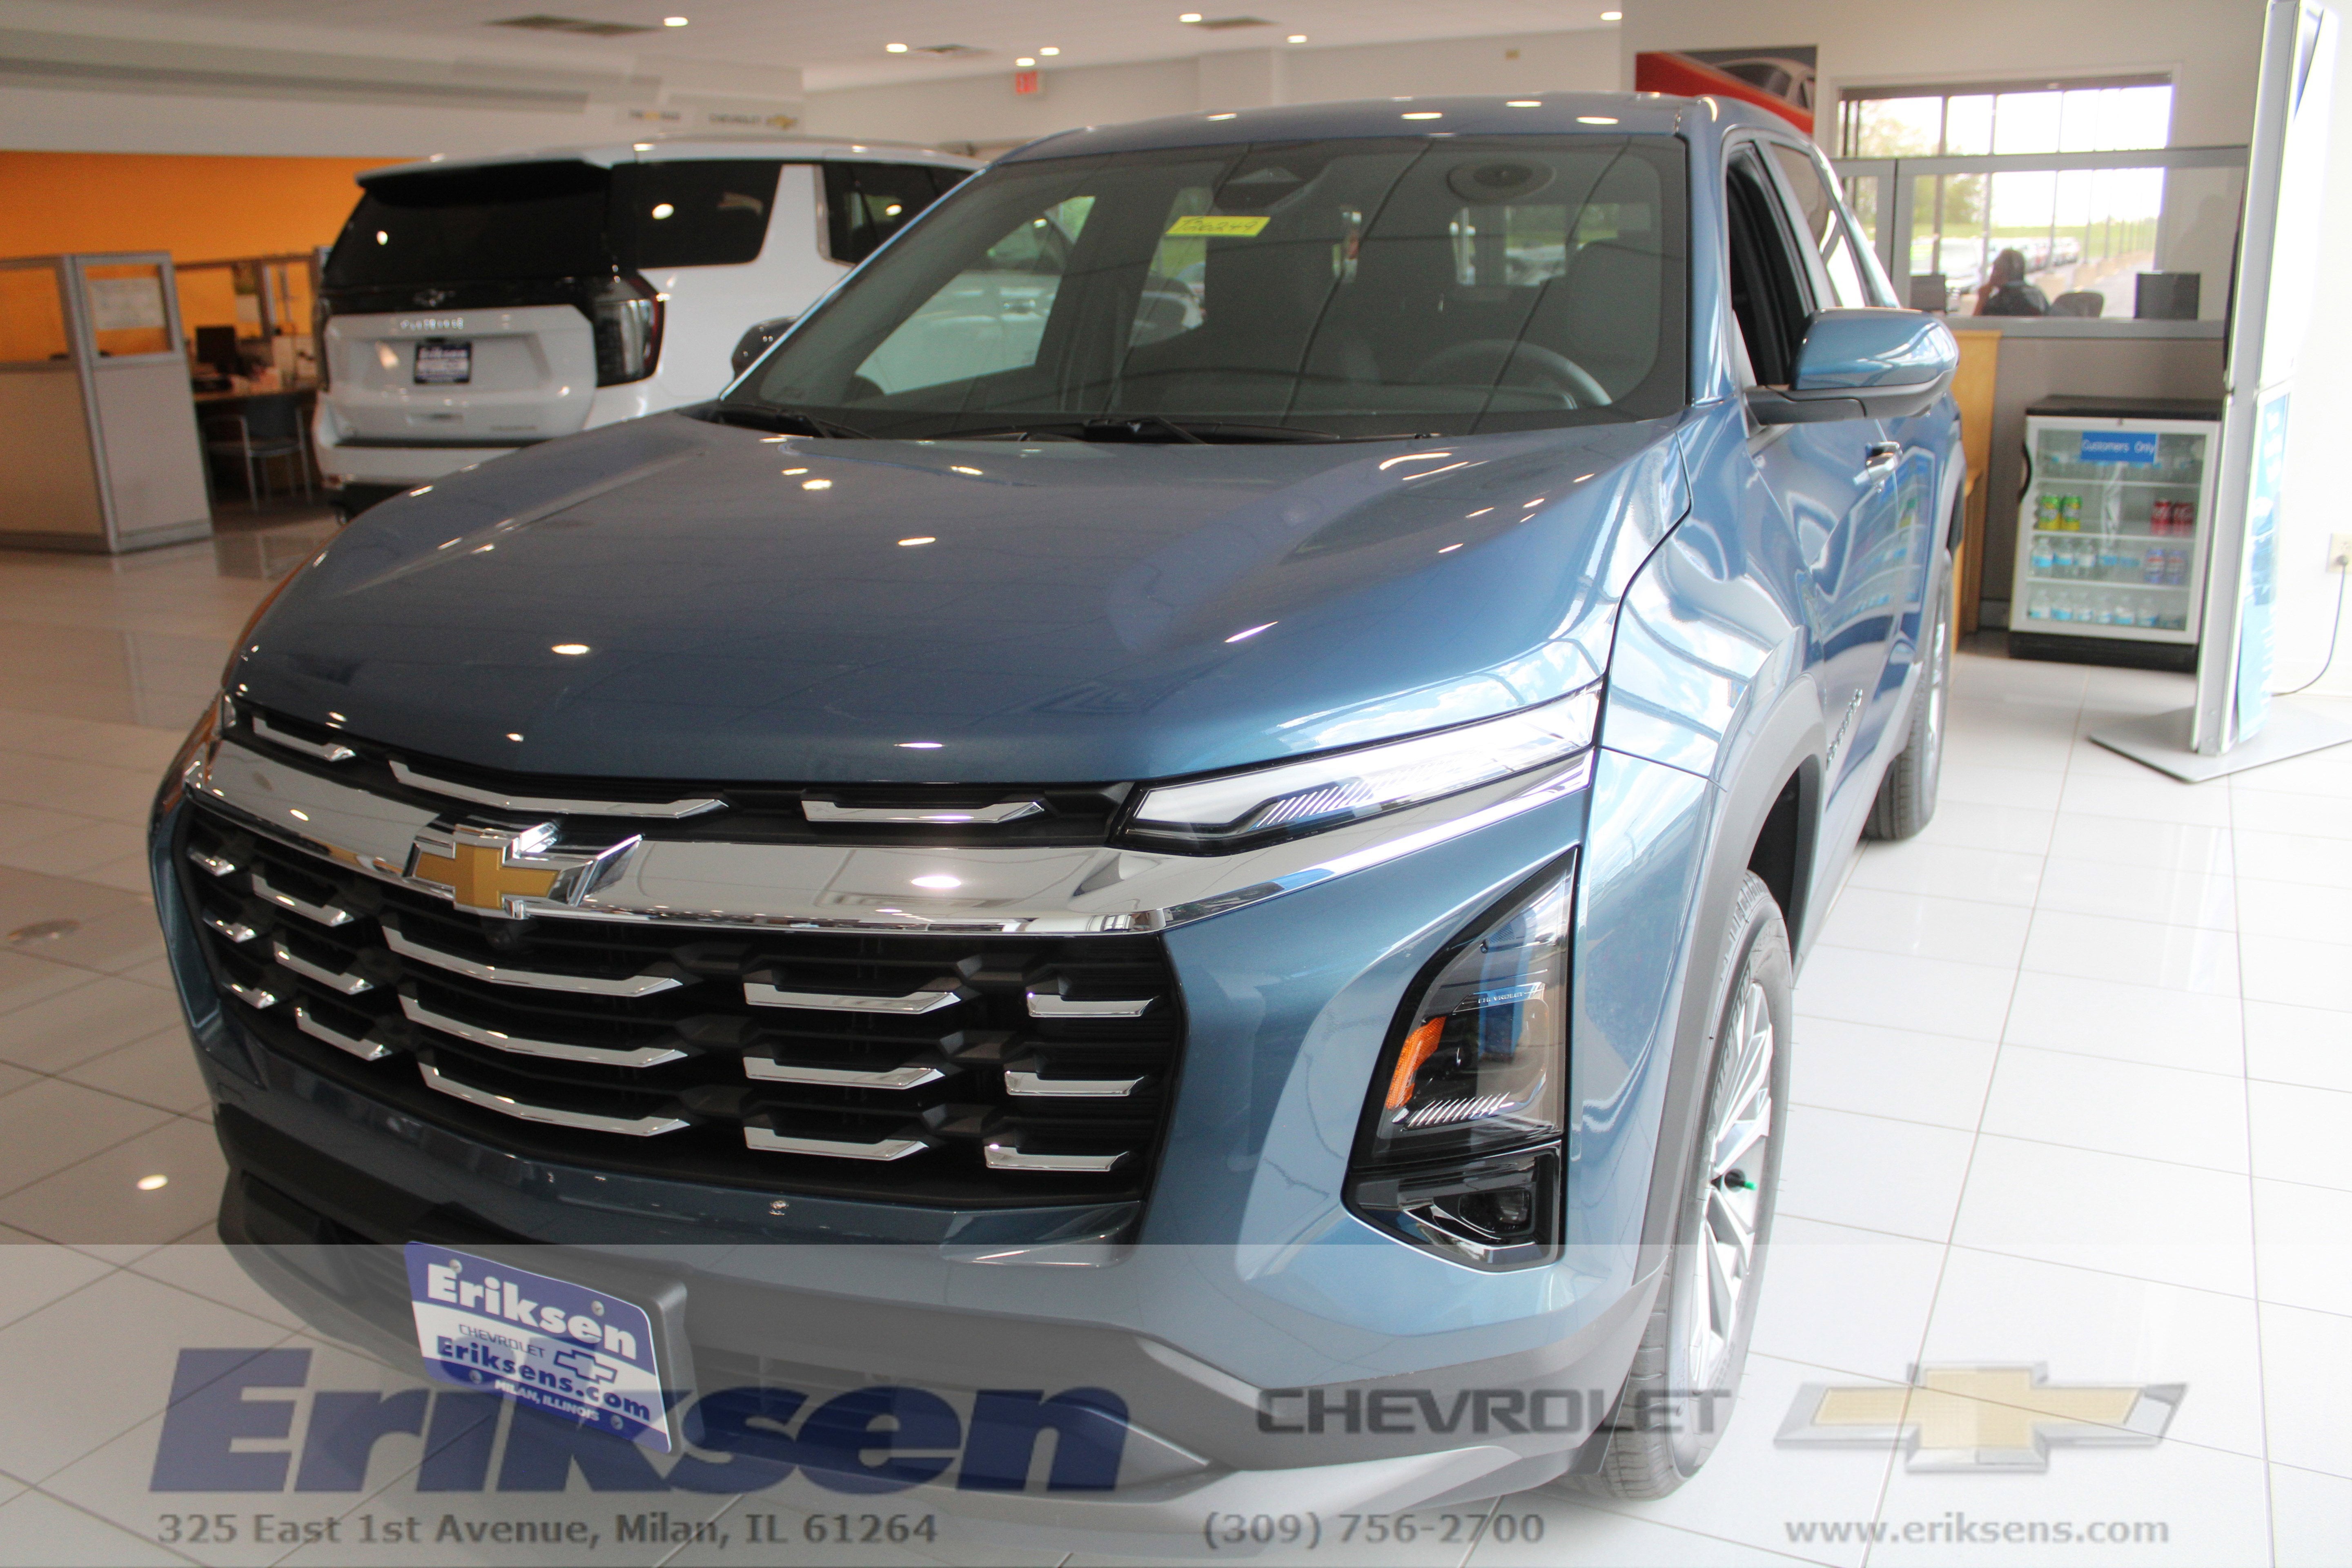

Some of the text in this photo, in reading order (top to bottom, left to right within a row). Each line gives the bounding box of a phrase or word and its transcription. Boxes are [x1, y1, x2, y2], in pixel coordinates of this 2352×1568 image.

[2134, 440, 2155, 455] Only
[428, 1263, 637, 1360] Eriksen
[459, 1324, 546, 1359] CHEVROLET
[437, 1335, 651, 1421] Eriksens.com
[494, 1379, 600, 1421] MILAN, ILLINOIS
